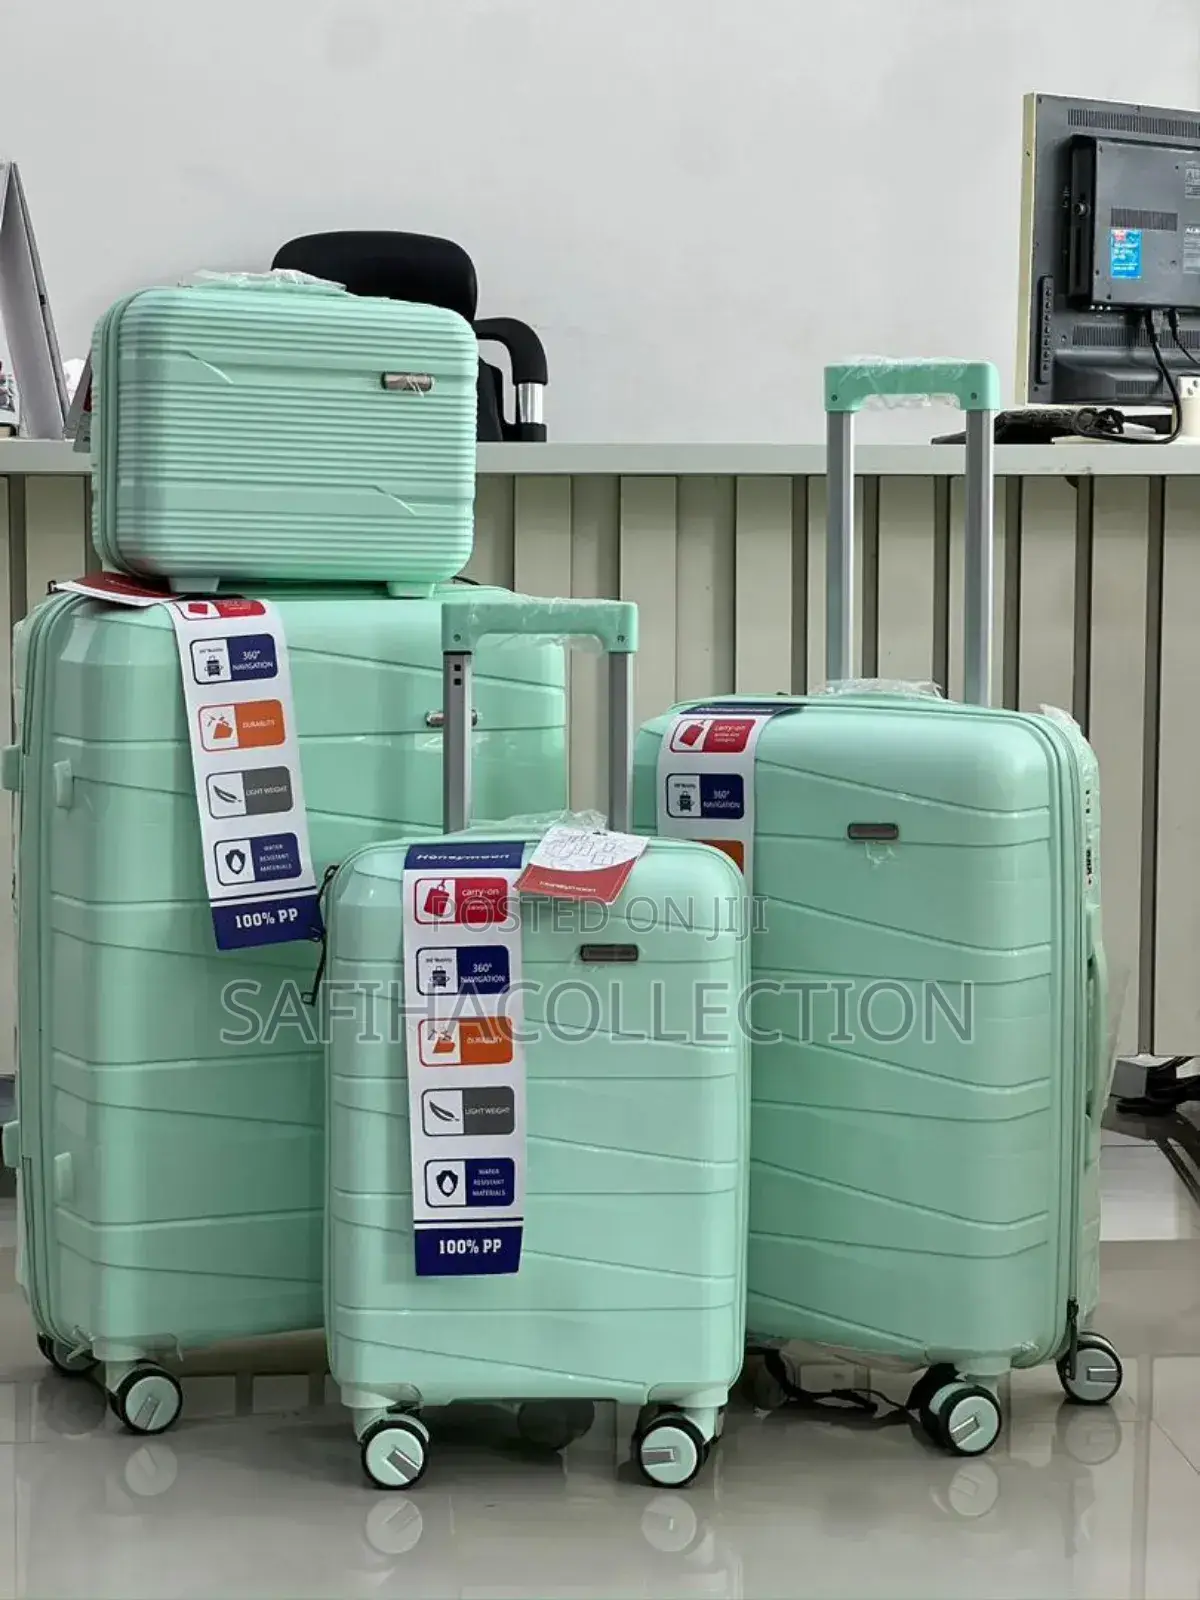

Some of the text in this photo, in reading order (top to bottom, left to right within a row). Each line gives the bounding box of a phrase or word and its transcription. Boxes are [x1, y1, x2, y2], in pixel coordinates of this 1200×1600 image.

[231, 660, 274, 671] NAVIGATION
[245, 784, 288, 797] LIGHT WEIGHT
[702, 800, 741, 809] NAVIGATION
[461, 887, 501, 897] carry-on
[234, 907, 300, 930] 100% PP
[460, 974, 506, 984] NAVIGATION
[465, 1105, 511, 1116] LIGHT WEIGHT
[472, 1189, 505, 1197] MATERIALS
[438, 1238, 503, 1255] 100% PP
